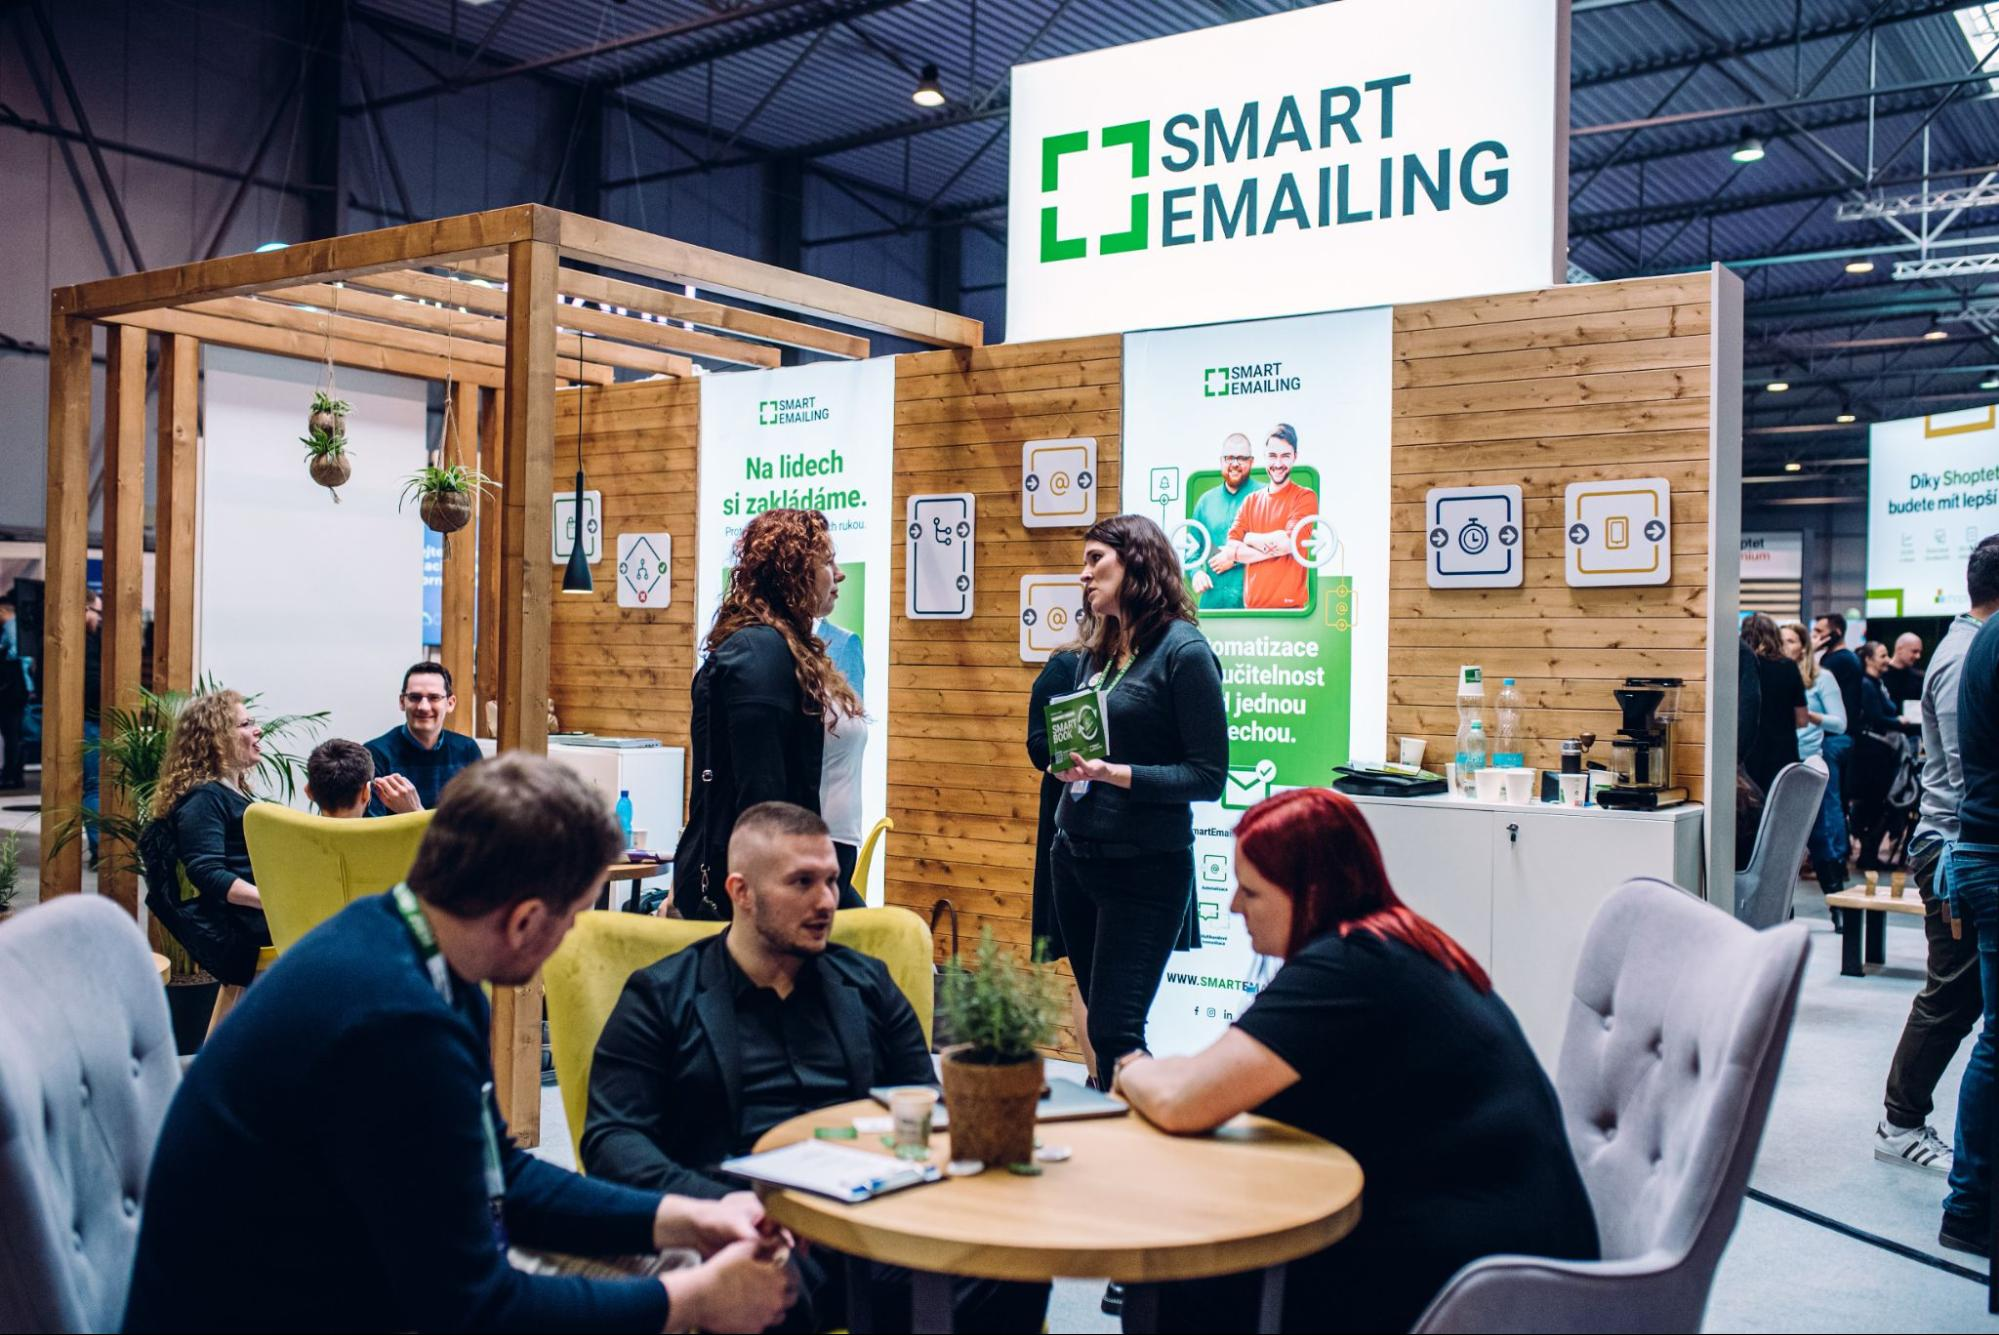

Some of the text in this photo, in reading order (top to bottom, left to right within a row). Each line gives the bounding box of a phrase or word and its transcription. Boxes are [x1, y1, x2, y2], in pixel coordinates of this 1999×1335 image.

[1161, 74, 1411, 172] SMART
[1161, 140, 1510, 247] EMAILING
[1231, 363, 1282, 379] SMART
[1231, 377, 1301, 395] EMAILING
[779, 396, 816, 411] SMART
[779, 408, 830, 424] EMAILING
[746, 449, 843, 480] Na lidech
[1910, 473, 1940, 490] Díky
[723, 486, 867, 515] si zakládáme.
[1888, 489, 1997, 514] budete mít lepší
[1740, 537, 1765, 550] ptet
[1207, 637, 1319, 658] omatizace
[1222, 664, 1325, 686] učitelnost
[1233, 693, 1307, 718] jednou
[1052, 719, 1077, 733] SMART
[1228, 721, 1297, 743] echou.
[1053, 729, 1073, 745] BOOK
